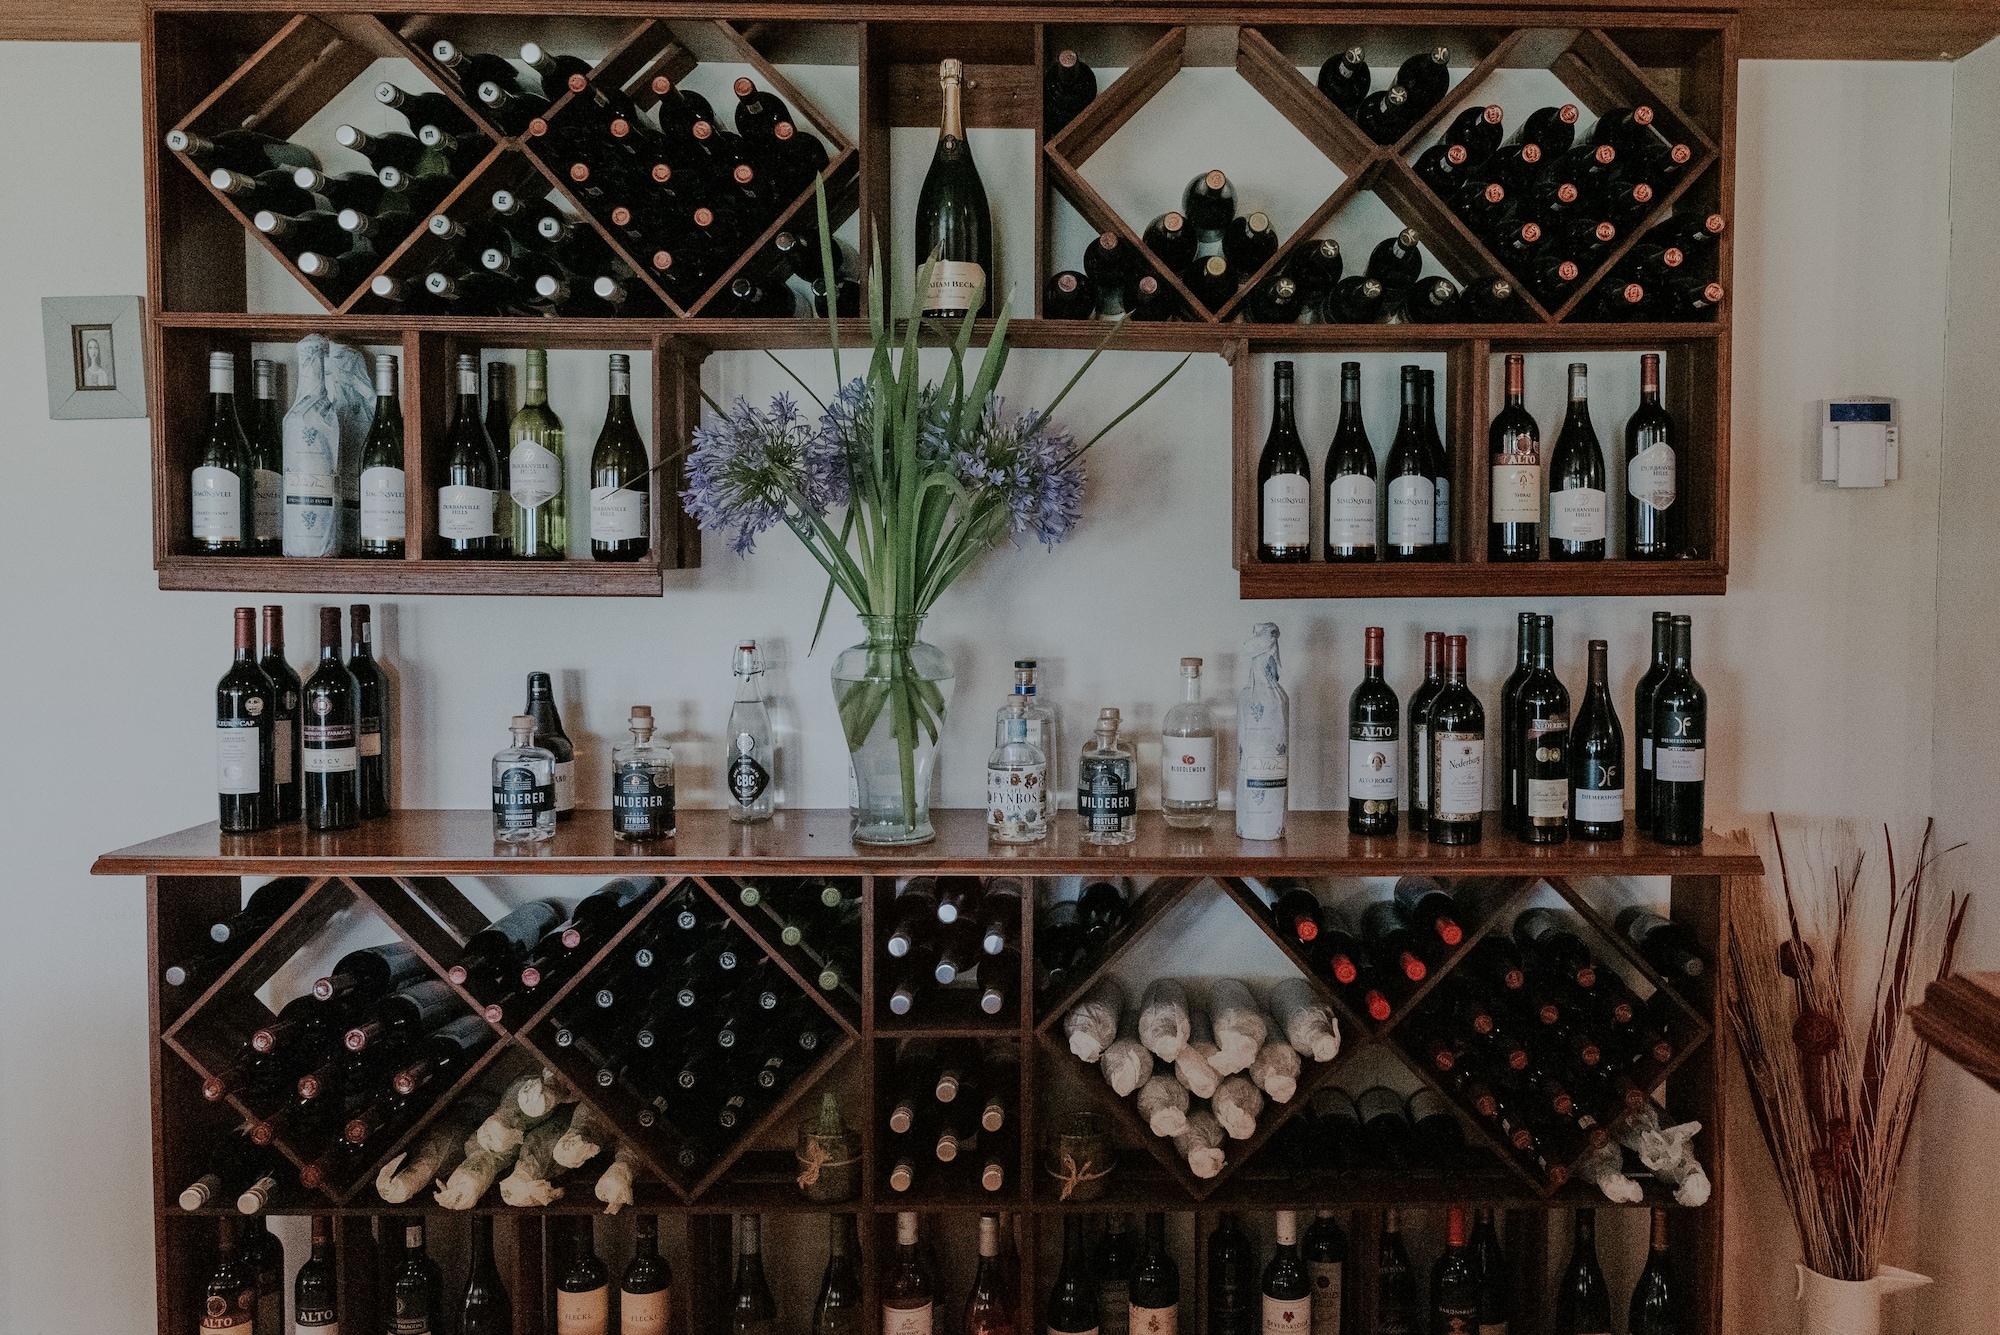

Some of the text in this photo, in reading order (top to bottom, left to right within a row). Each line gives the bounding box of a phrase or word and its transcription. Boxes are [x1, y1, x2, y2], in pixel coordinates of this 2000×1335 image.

[928, 280, 975, 289] AHAM BECK
[1508, 455, 1536, 465] ALTO
[239, 719, 256, 728] CAP
[1360, 726, 1393, 737] ALTO
[736, 774, 756, 788] CBC
[494, 791, 546, 806] WILDERER
[614, 794, 664, 809] WILDERER
[993, 793, 1038, 804] FYNBOS
[1081, 795, 1131, 810] WILDERER
[625, 816, 650, 825] FYNBOS
[300, 1309, 335, 1323] ALTO
[203, 1317, 233, 1329] ALTO
